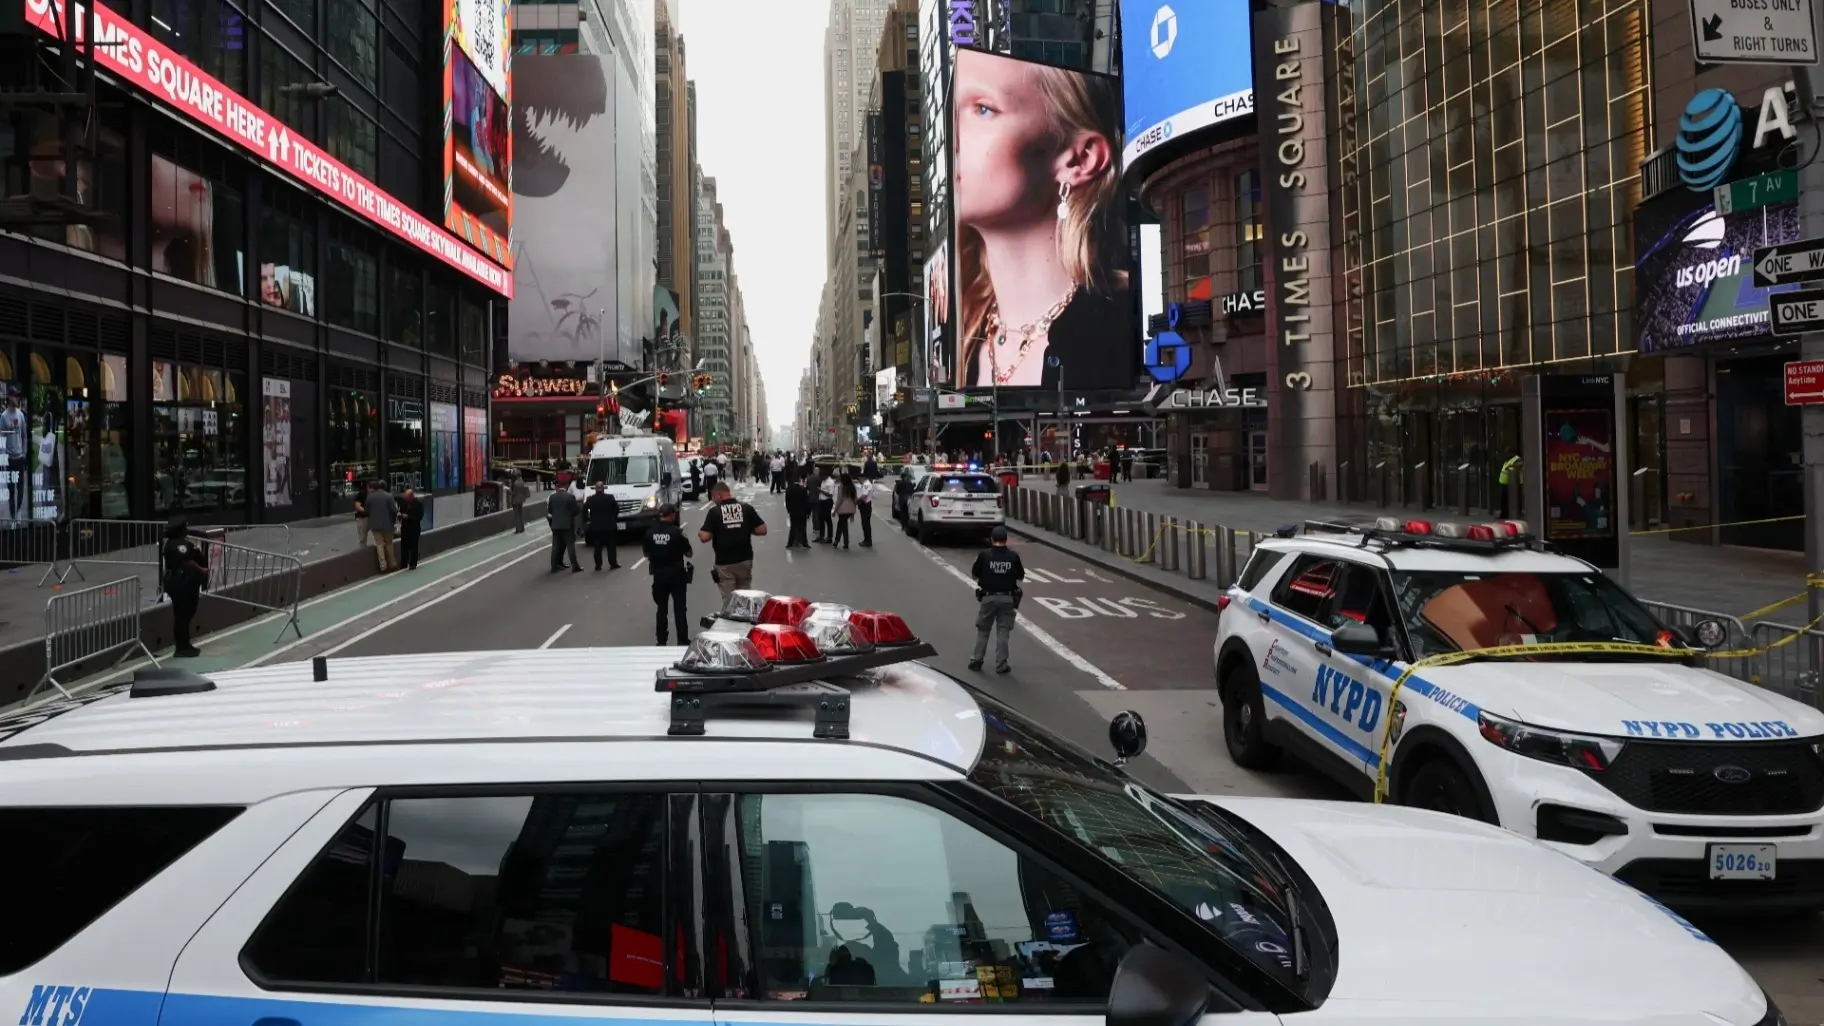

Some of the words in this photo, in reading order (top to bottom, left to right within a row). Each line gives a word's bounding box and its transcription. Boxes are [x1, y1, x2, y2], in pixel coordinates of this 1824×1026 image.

[1730, 0, 1768, 10] BUSES
[1772, 0, 1802, 12] ONLY
[1763, 16, 1774, 31] &
[1733, 35, 1767, 51] RIGHT
[1770, 37, 1809, 53] TURNS
[1274, 38, 1306, 189] SQUARE
[1136, 126, 1162, 153] CHASE
[148, 49, 223, 122] SQUARE
[227, 97, 265, 147] HERE
[293, 141, 340, 192] TICKETS
[341, 171, 356, 201] TO
[356, 182, 375, 214] THE
[375, 194, 401, 229] TIMES
[401, 211, 431, 247] SQUARE
[430, 230, 462, 266] SKYWALK
[1748, 181, 1758, 203] 7
[1766, 177, 1782, 193] AV
[1676, 266, 1694, 289] us
[1694, 253, 1741, 289] open
[1764, 256, 1793, 274] ONE
[1281, 230, 1312, 346] TIMES
[1782, 302, 1819, 321] ONE
[1677, 321, 1709, 337] OFFICIAL
[1286, 371, 1312, 389] 3
[1787, 366, 1798, 375] NO
[499, 373, 587, 397] Subway
[1788, 375, 1817, 389] Anytime
[1171, 387, 1258, 408] CHASE
[720, 503, 743, 514] NYPD
[653, 533, 671, 542] NYPD
[990, 560, 1012, 570] NYPD
[1032, 596, 1187, 620] BUS
[1312, 663, 1383, 733] NYPD
[1428, 686, 1466, 714] POLICE
[1621, 719, 1701, 739] NYPD
[1705, 720, 1799, 739] POLICE
[1715, 854, 1757, 872] 5026
[1757, 861, 1771, 872] 20
[19, 984, 90, 1026] MTS
